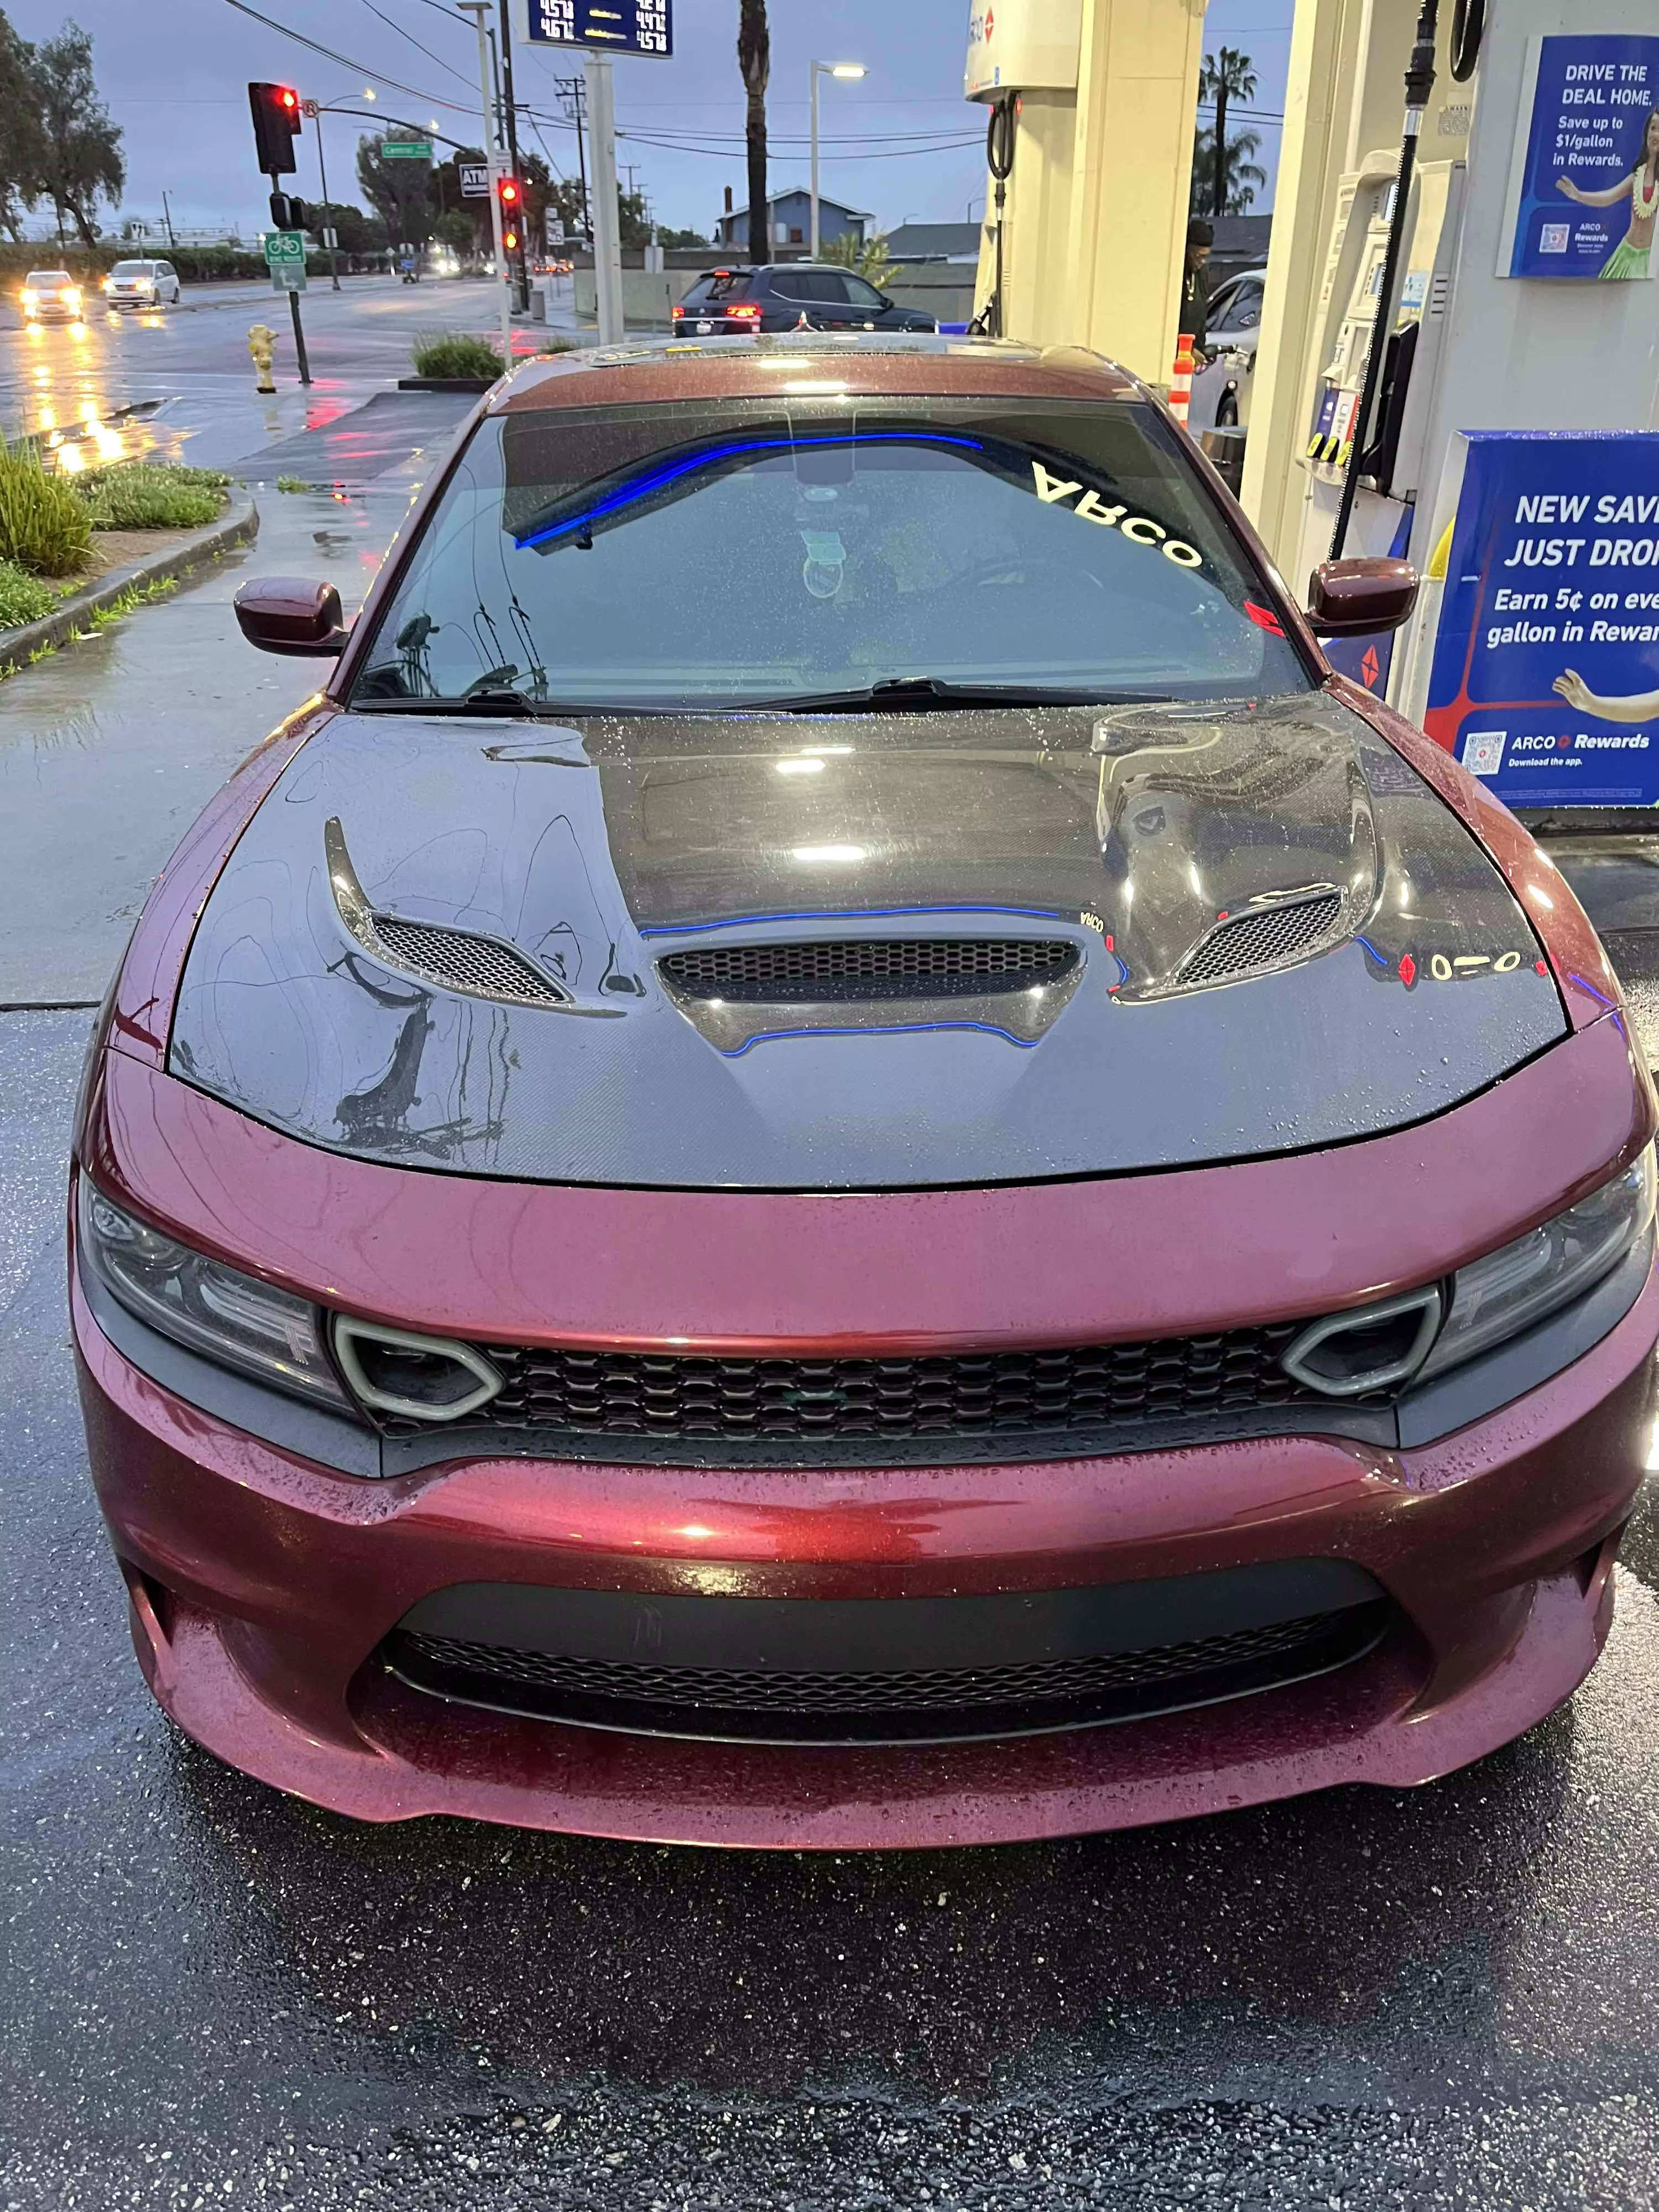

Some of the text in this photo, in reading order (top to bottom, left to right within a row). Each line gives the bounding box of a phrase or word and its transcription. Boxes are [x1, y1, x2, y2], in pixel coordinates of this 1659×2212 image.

[1566, 65, 1647, 81] DRIVE THE
[1562, 88, 1652, 106] DEAL HOME.
[1558, 116, 1624, 132] Save up to
[1556, 133, 1613, 150] $1/gallon
[1553, 153, 1624, 166] in Rewards.
[1575, 233, 1609, 242] Rewards
[1515, 495, 1659, 523] NEW SAV
[1504, 539, 1585, 566] JUST
[1495, 588, 1548, 610] Earn
[1555, 588, 1583, 612] 5¢
[1590, 593, 1619, 609] on
[1487, 621, 1556, 649] gallon
[1562, 620, 1584, 641] in
[1511, 734, 1650, 750] ARCO Rewards
[1509, 758, 1583, 767] Download the app.
